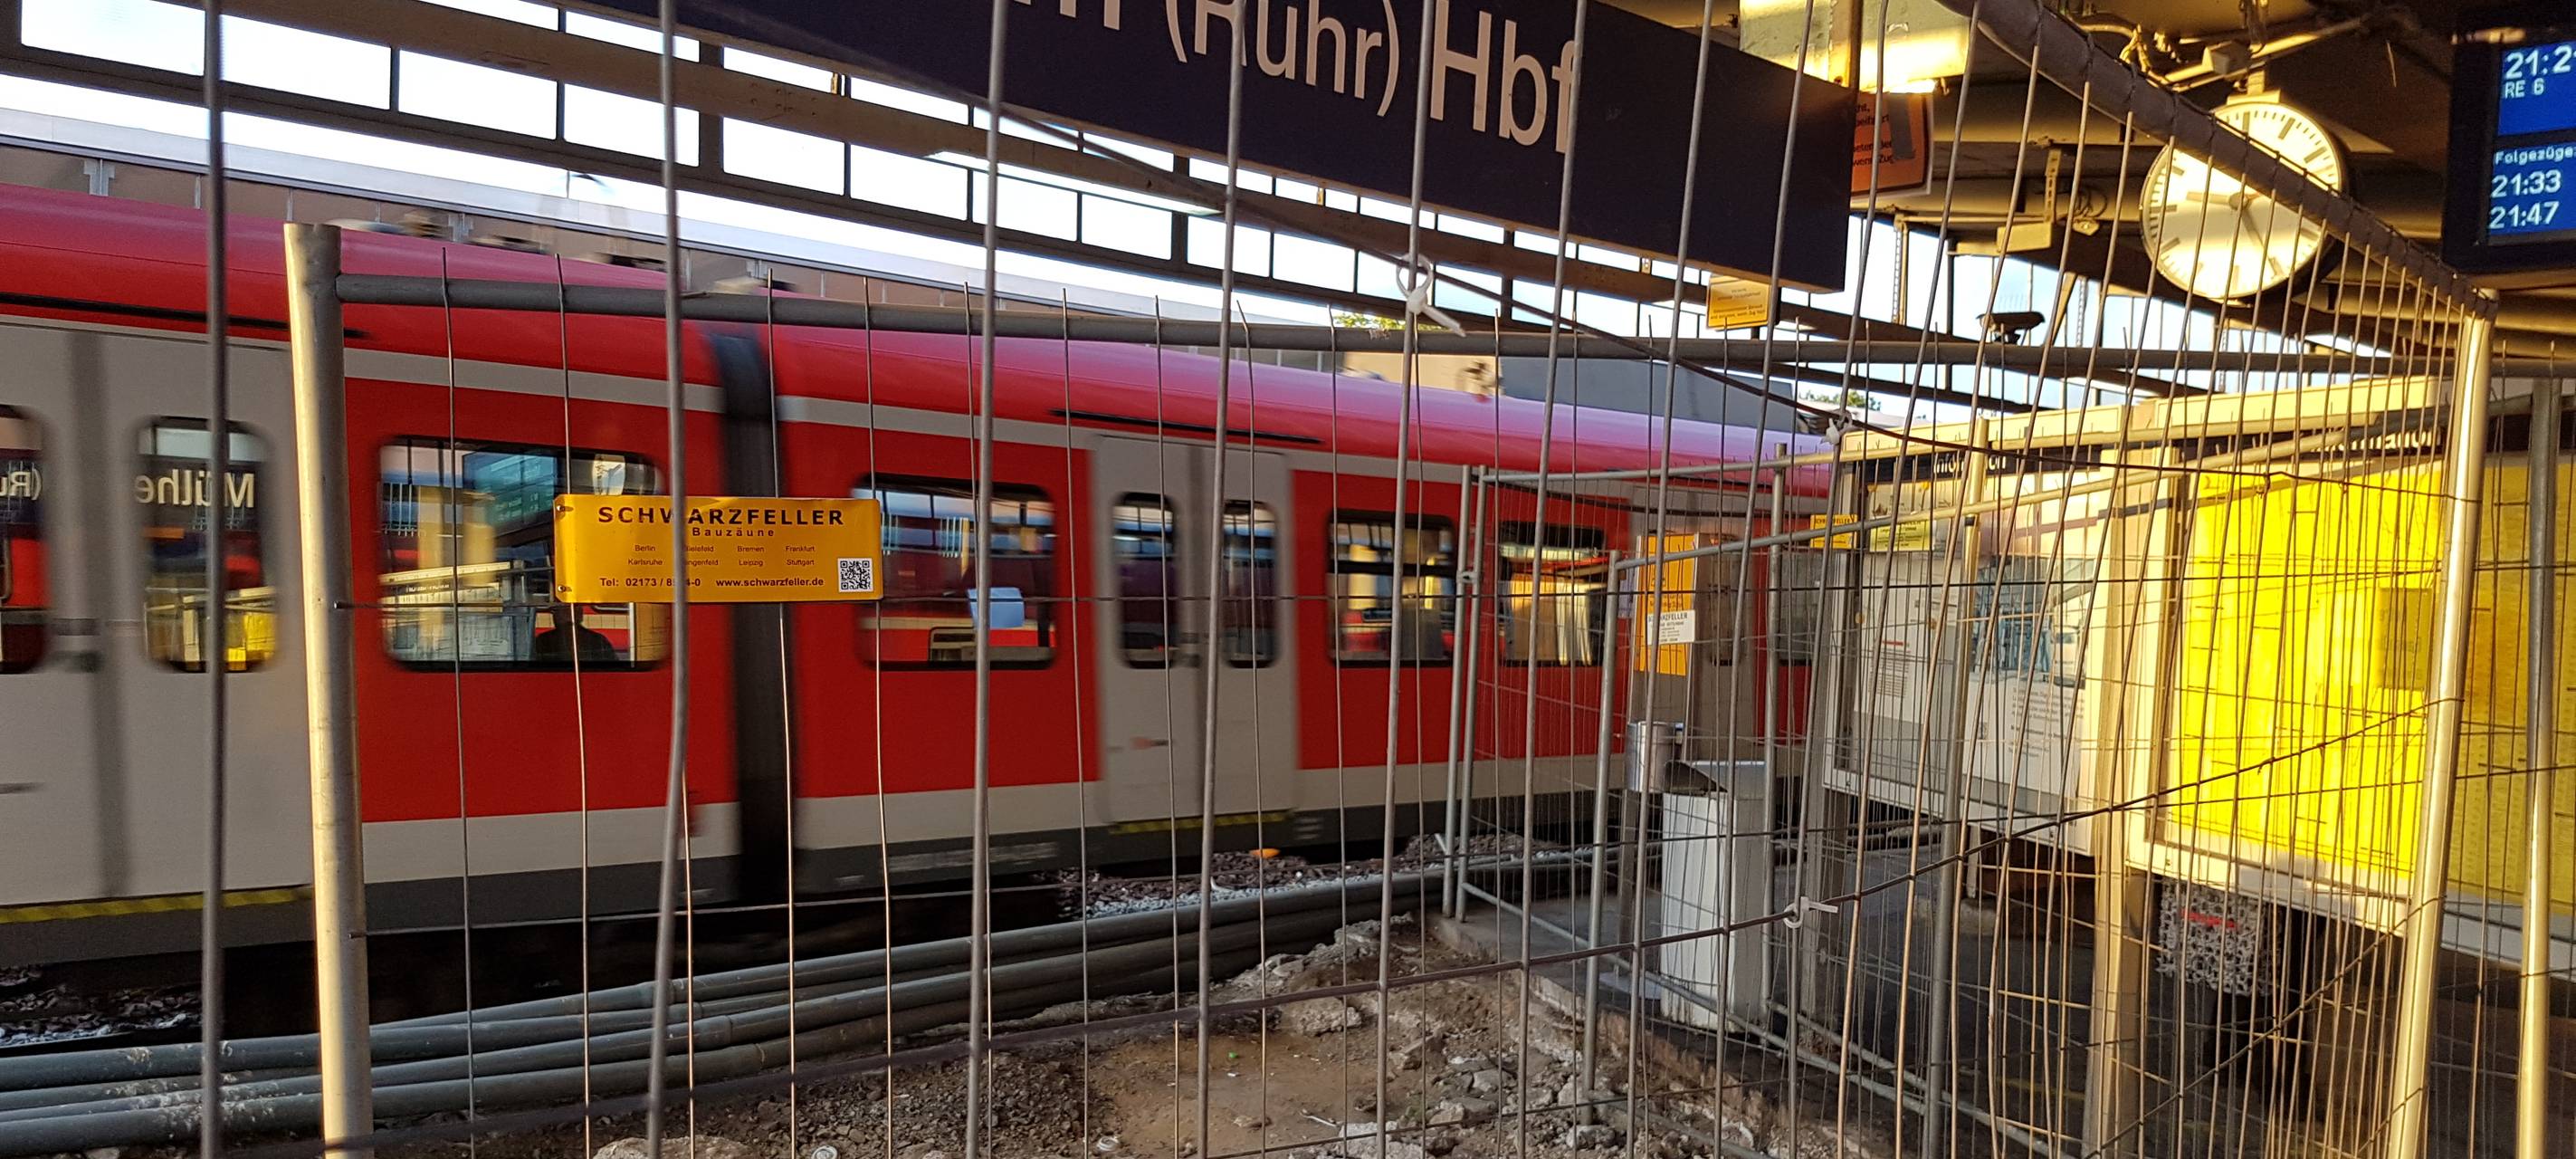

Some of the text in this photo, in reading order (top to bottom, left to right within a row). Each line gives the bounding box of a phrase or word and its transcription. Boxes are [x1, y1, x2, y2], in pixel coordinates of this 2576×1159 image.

[2505, 43, 2576, 81] 21:2
[1429, 0, 1582, 155] Hbf
[2504, 78, 2545, 100] RE 6
[2491, 168, 2562, 198] 21:33
[2489, 200, 2560, 229] 21:47
[692, 527, 775, 538] Bauzäune
[685, 545, 715, 553] ielefeld
[737, 545, 765, 553] Bremen
[785, 545, 816, 553] Frankfurt
[627, 558, 815, 568] Karlsruhe ngenfeld Leipzig Stuttgart
[599, 578, 619, 587] Tel:
[625, 578, 657, 588] 02173
[716, 577, 824, 588] www.schwarzfeller.de
